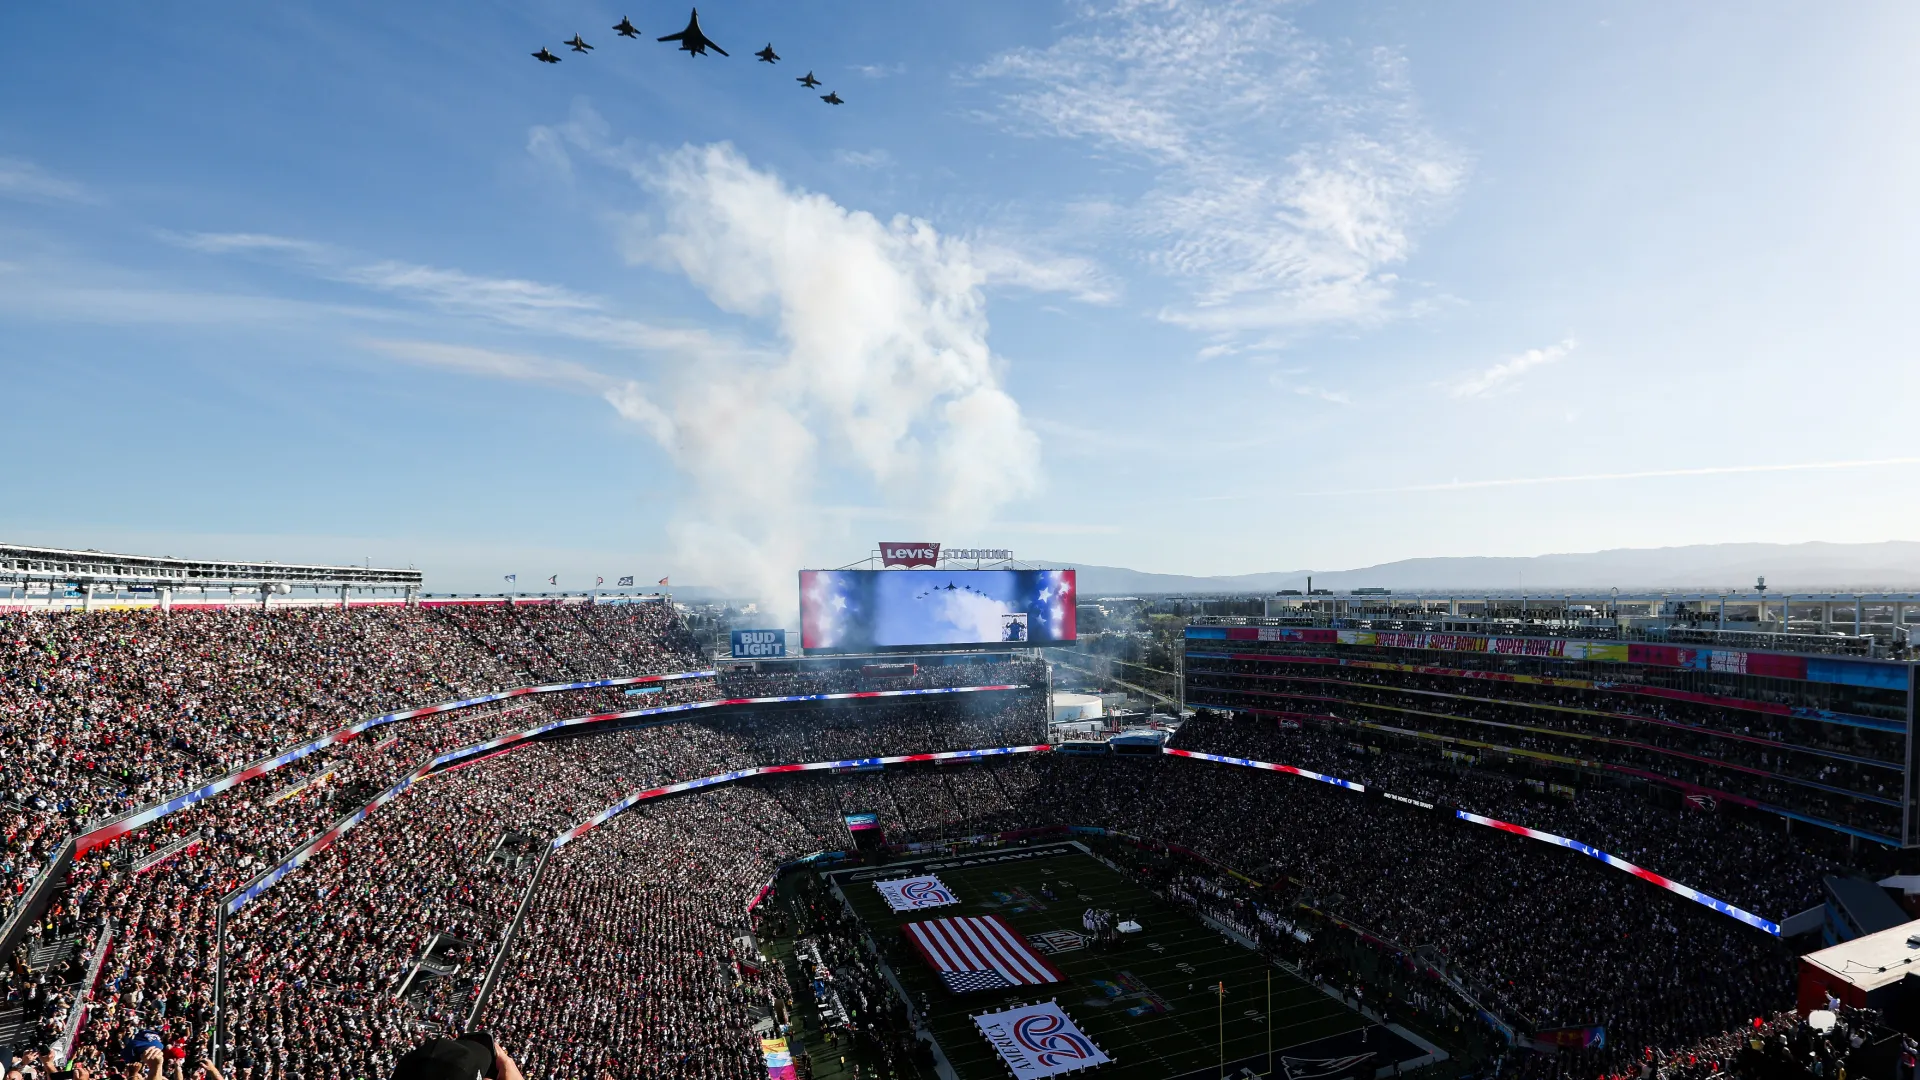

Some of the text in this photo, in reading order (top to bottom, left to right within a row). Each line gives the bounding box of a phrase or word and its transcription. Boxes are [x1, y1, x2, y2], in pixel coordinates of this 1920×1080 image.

[944, 548, 1009, 560] STADIUM
[741, 632, 776, 644] BUD
[1375, 632, 1396, 647] SUPER
[1397, 633, 1416, 648] BOWL
[1430, 634, 1490, 653] SUPER BOWL LX
[734, 643, 783, 656] LIGHT
[1495, 637, 1567, 657] SUPER BOWL LX
[923, 848, 1068, 871] SEAHAWKS
[987, 1023, 1035, 1071] AMERICA
